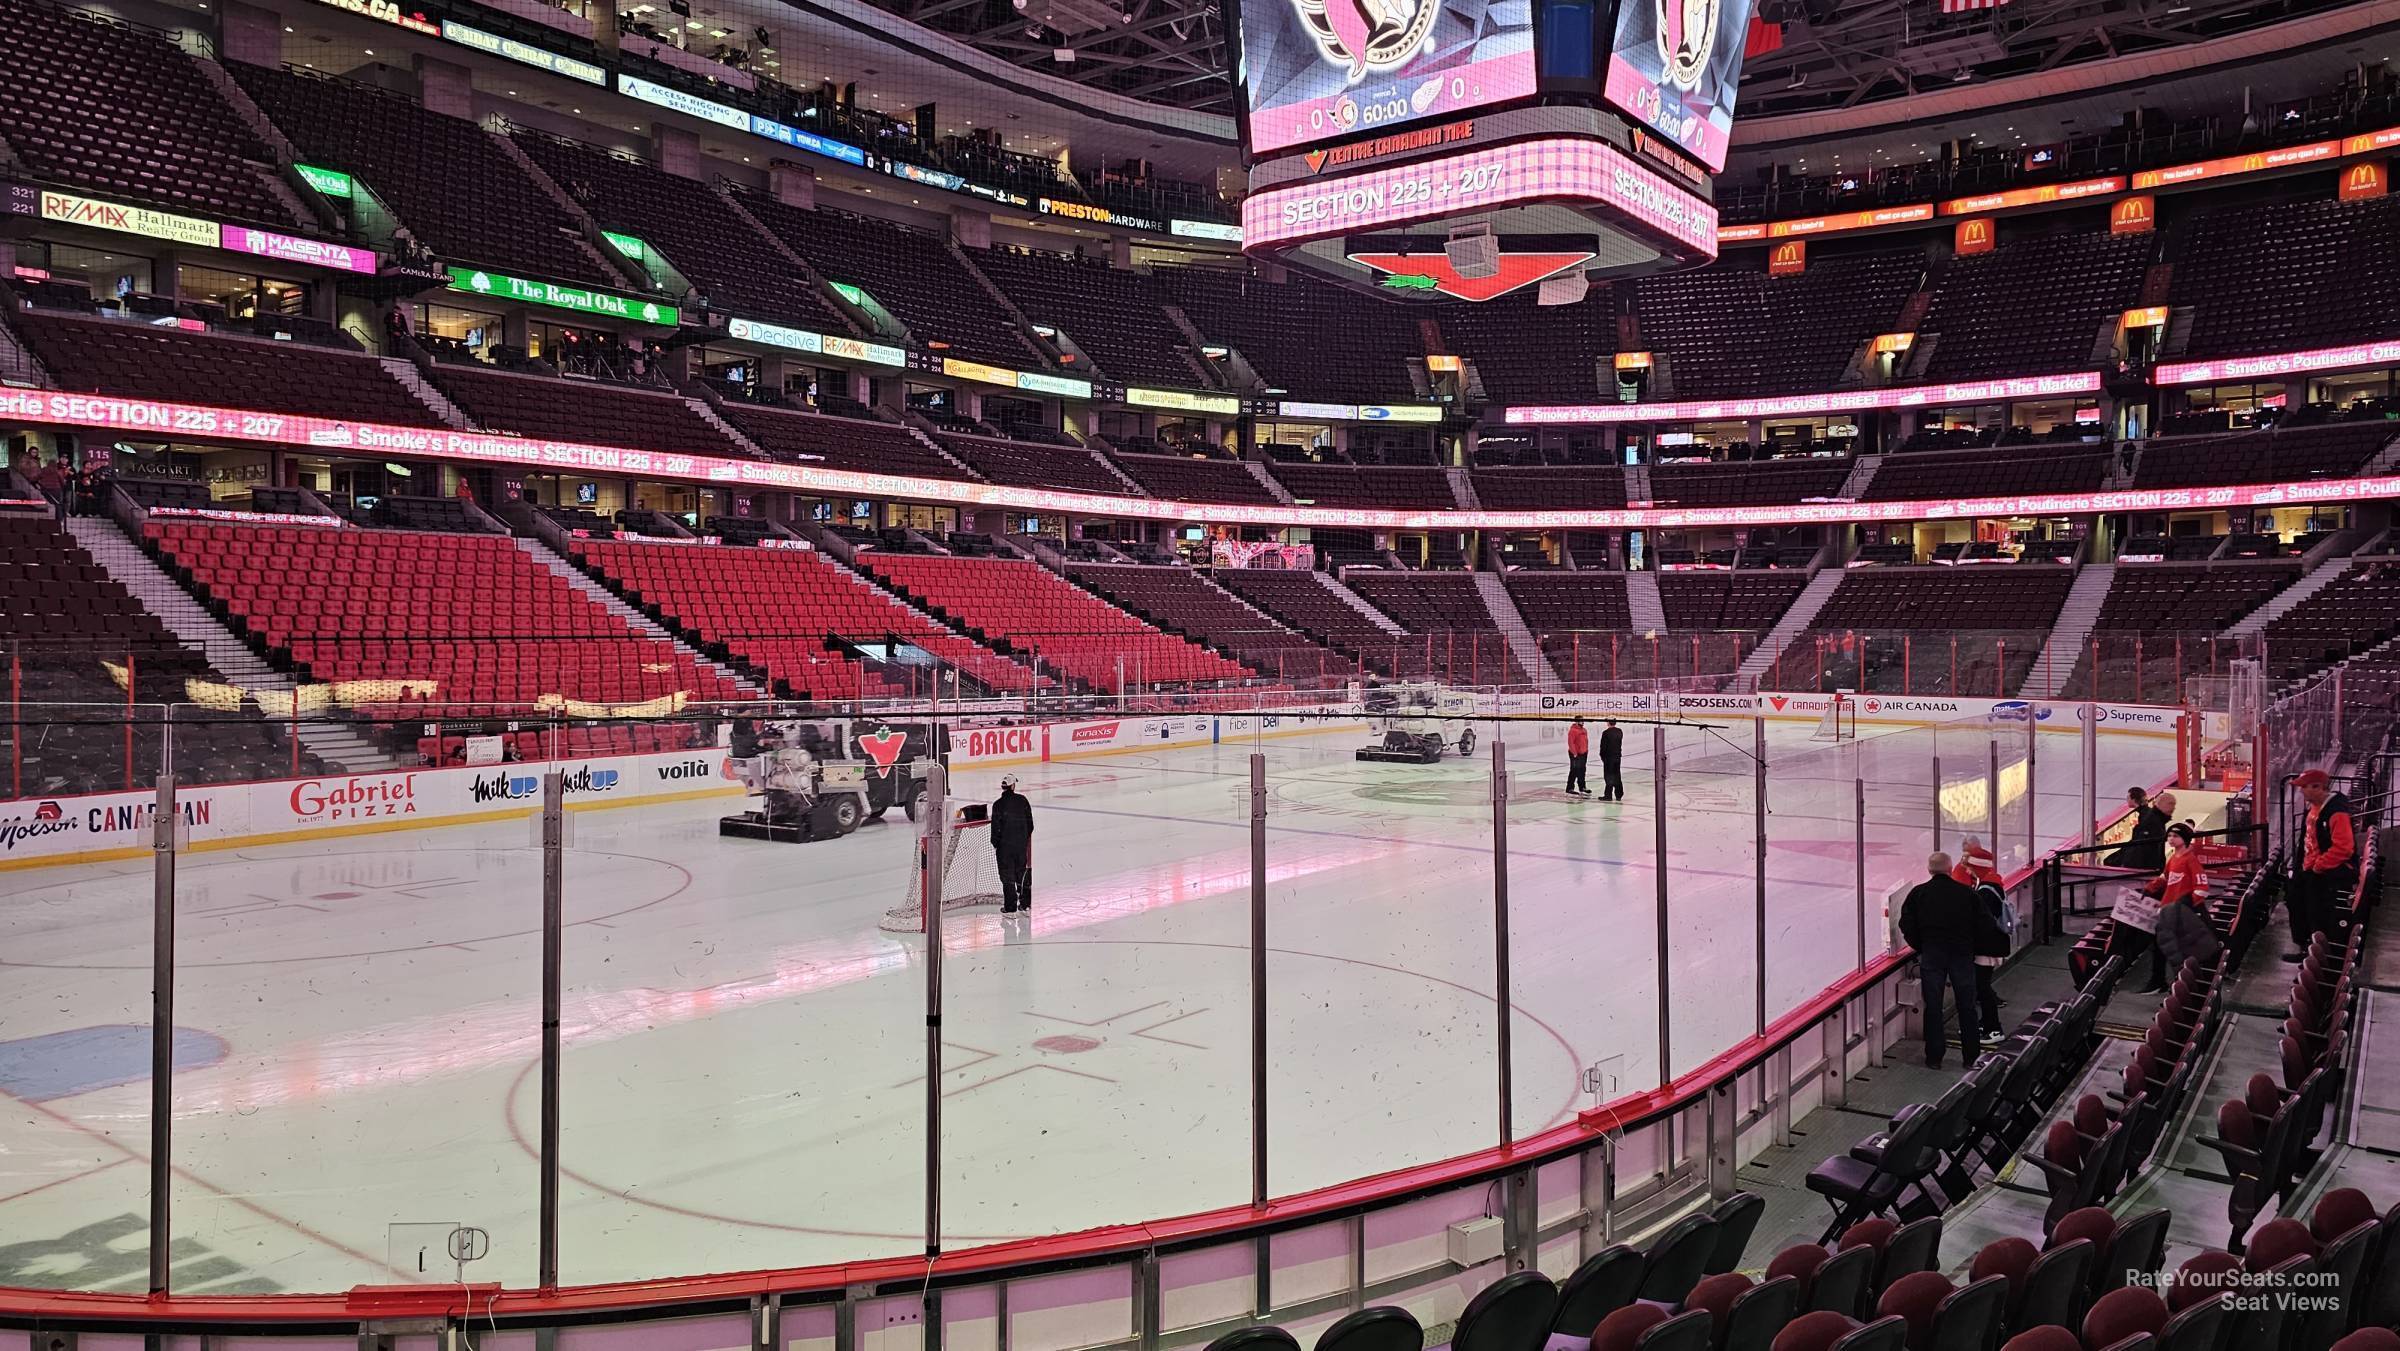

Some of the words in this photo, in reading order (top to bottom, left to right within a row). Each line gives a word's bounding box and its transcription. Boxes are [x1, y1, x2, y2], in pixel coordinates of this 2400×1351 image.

[1451, 78, 1464, 98] 0
[1638, 87, 1645, 108] 0
[651, 87, 686, 103] ACCESS
[690, 98, 730, 116] RIGGING
[669, 101, 713, 118] SERVICES
[1363, 99, 1408, 124] 60:00
[1311, 109, 1323, 129] 0
[1659, 111, 1680, 137] 60:00
[1330, 141, 1374, 165] CENTRE
[1375, 128, 1442, 155] CANADIAN
[1444, 120, 1473, 140] TIRE
[1696, 127, 1703, 147] 0
[11, 187, 35, 199] 321
[1283, 186, 1385, 225] SECTION
[1391, 178, 1433, 207] 225
[1438, 182, 1453, 198] +
[1459, 163, 1503, 193] 207
[12, 202, 34, 214] 221
[46, 195, 130, 228] RE/MAX
[1614, 167, 1664, 215] SECTION
[1664, 197, 1684, 227] 225
[1691, 213, 1708, 240] 207
[137, 210, 215, 235] Hallmark
[137, 222, 177, 240] Realty
[180, 229, 215, 246] Group
[269, 236, 351, 260] MAGENTA
[401, 267, 431, 279] CAMERA
[432, 272, 454, 283] STAND
[508, 277, 543, 298] The
[546, 284, 591, 308] Royal
[595, 294, 628, 314] Oak
[751, 324, 815, 350] Decisive
[907, 352, 919, 360] 323
[931, 355, 942, 364] 324
[907, 361, 918, 369] 223
[2225, 358, 2289, 376] Smoke's
[2293, 350, 2367, 367] Poutinerie
[1945, 385, 1988, 400] Down
[1990, 383, 2003, 396] In
[2007, 380, 2034, 395] The
[2038, 377, 2090, 392] Market
[1532, 408, 1579, 420] Smoke's
[1580, 407, 1635, 420] Poutinerie
[1638, 406, 1676, 418] Ottawa
[1735, 403, 1756, 414] 407
[1831, 394, 1880, 406] STREET
[50, 396, 169, 427] SECTION
[174, 409, 216, 431] 225
[224, 420, 236, 432] +
[242, 415, 284, 437] 207
[88, 450, 109, 460] 115
[357, 426, 442, 452] Smoke's
[448, 436, 539, 460] Poutinerie
[543, 446, 619, 467] SECTION
[623, 453, 650, 471] 225
[654, 461, 663, 471] +
[666, 458, 694, 473] 207
[506, 480, 521, 489] 116
[741, 464, 799, 483] Smoke's
[802, 469, 863, 490] Poutinerie
[866, 476, 918, 493] SECTION
[920, 482, 938, 495] 225
[952, 484, 969, 497] 207
[1004, 488, 1043, 505] Smoke's
[1045, 494, 1089, 510] Poutinerie
[1089, 498, 1131, 512] SECTION
[1134, 502, 1149, 513] 225
[1159, 502, 1174, 514] 207
[1959, 500, 2014, 514] Smoke's
[2018, 497, 2090, 512] Poutinerie
[2093, 492, 2160, 509] SECTION
[2163, 491, 2190, 505] 225
[2207, 490, 2235, 503] 207
[2287, 484, 2355, 500] Smoke's
[738, 499, 750, 507] 116
[1205, 507, 1246, 521] Smoke's
[1247, 508, 1295, 522] Poutinerie
[1299, 510, 1344, 523] SECTION
[1347, 512, 1365, 523] 225
[1375, 512, 1393, 523] 207
[1431, 513, 1475, 525] Smoke's
[1478, 513, 1533, 525] Poutinerie
[1536, 513, 1588, 524] SECTION
[1591, 513, 1610, 524] 225
[1624, 512, 1644, 523] 207
[1685, 510, 1733, 523] Smoke's
[1735, 507, 1791, 521] Poutinerie
[1794, 506, 1847, 519] SECTION
[1850, 505, 1870, 517] 225
[1883, 505, 1904, 517] 207
[1597, 699, 1622, 709] Fibe
[1632, 696, 1650, 708] Bell
[1884, 702, 1903, 711] AIR
[1905, 702, 1958, 712] CANADA
[1229, 718, 1248, 730] Fibe
[2110, 709, 2162, 723] Supreme
[951, 735, 967, 749] The
[969, 729, 1033, 757] BRICK
[658, 759, 709, 780] voilà
[290, 774, 416, 815] Gabriel
[307, 815, 324, 823] 1977
[331, 803, 417, 820] PIZZA
[0, 814, 78, 850] Molson
[2195, 872, 2208, 886] 19
